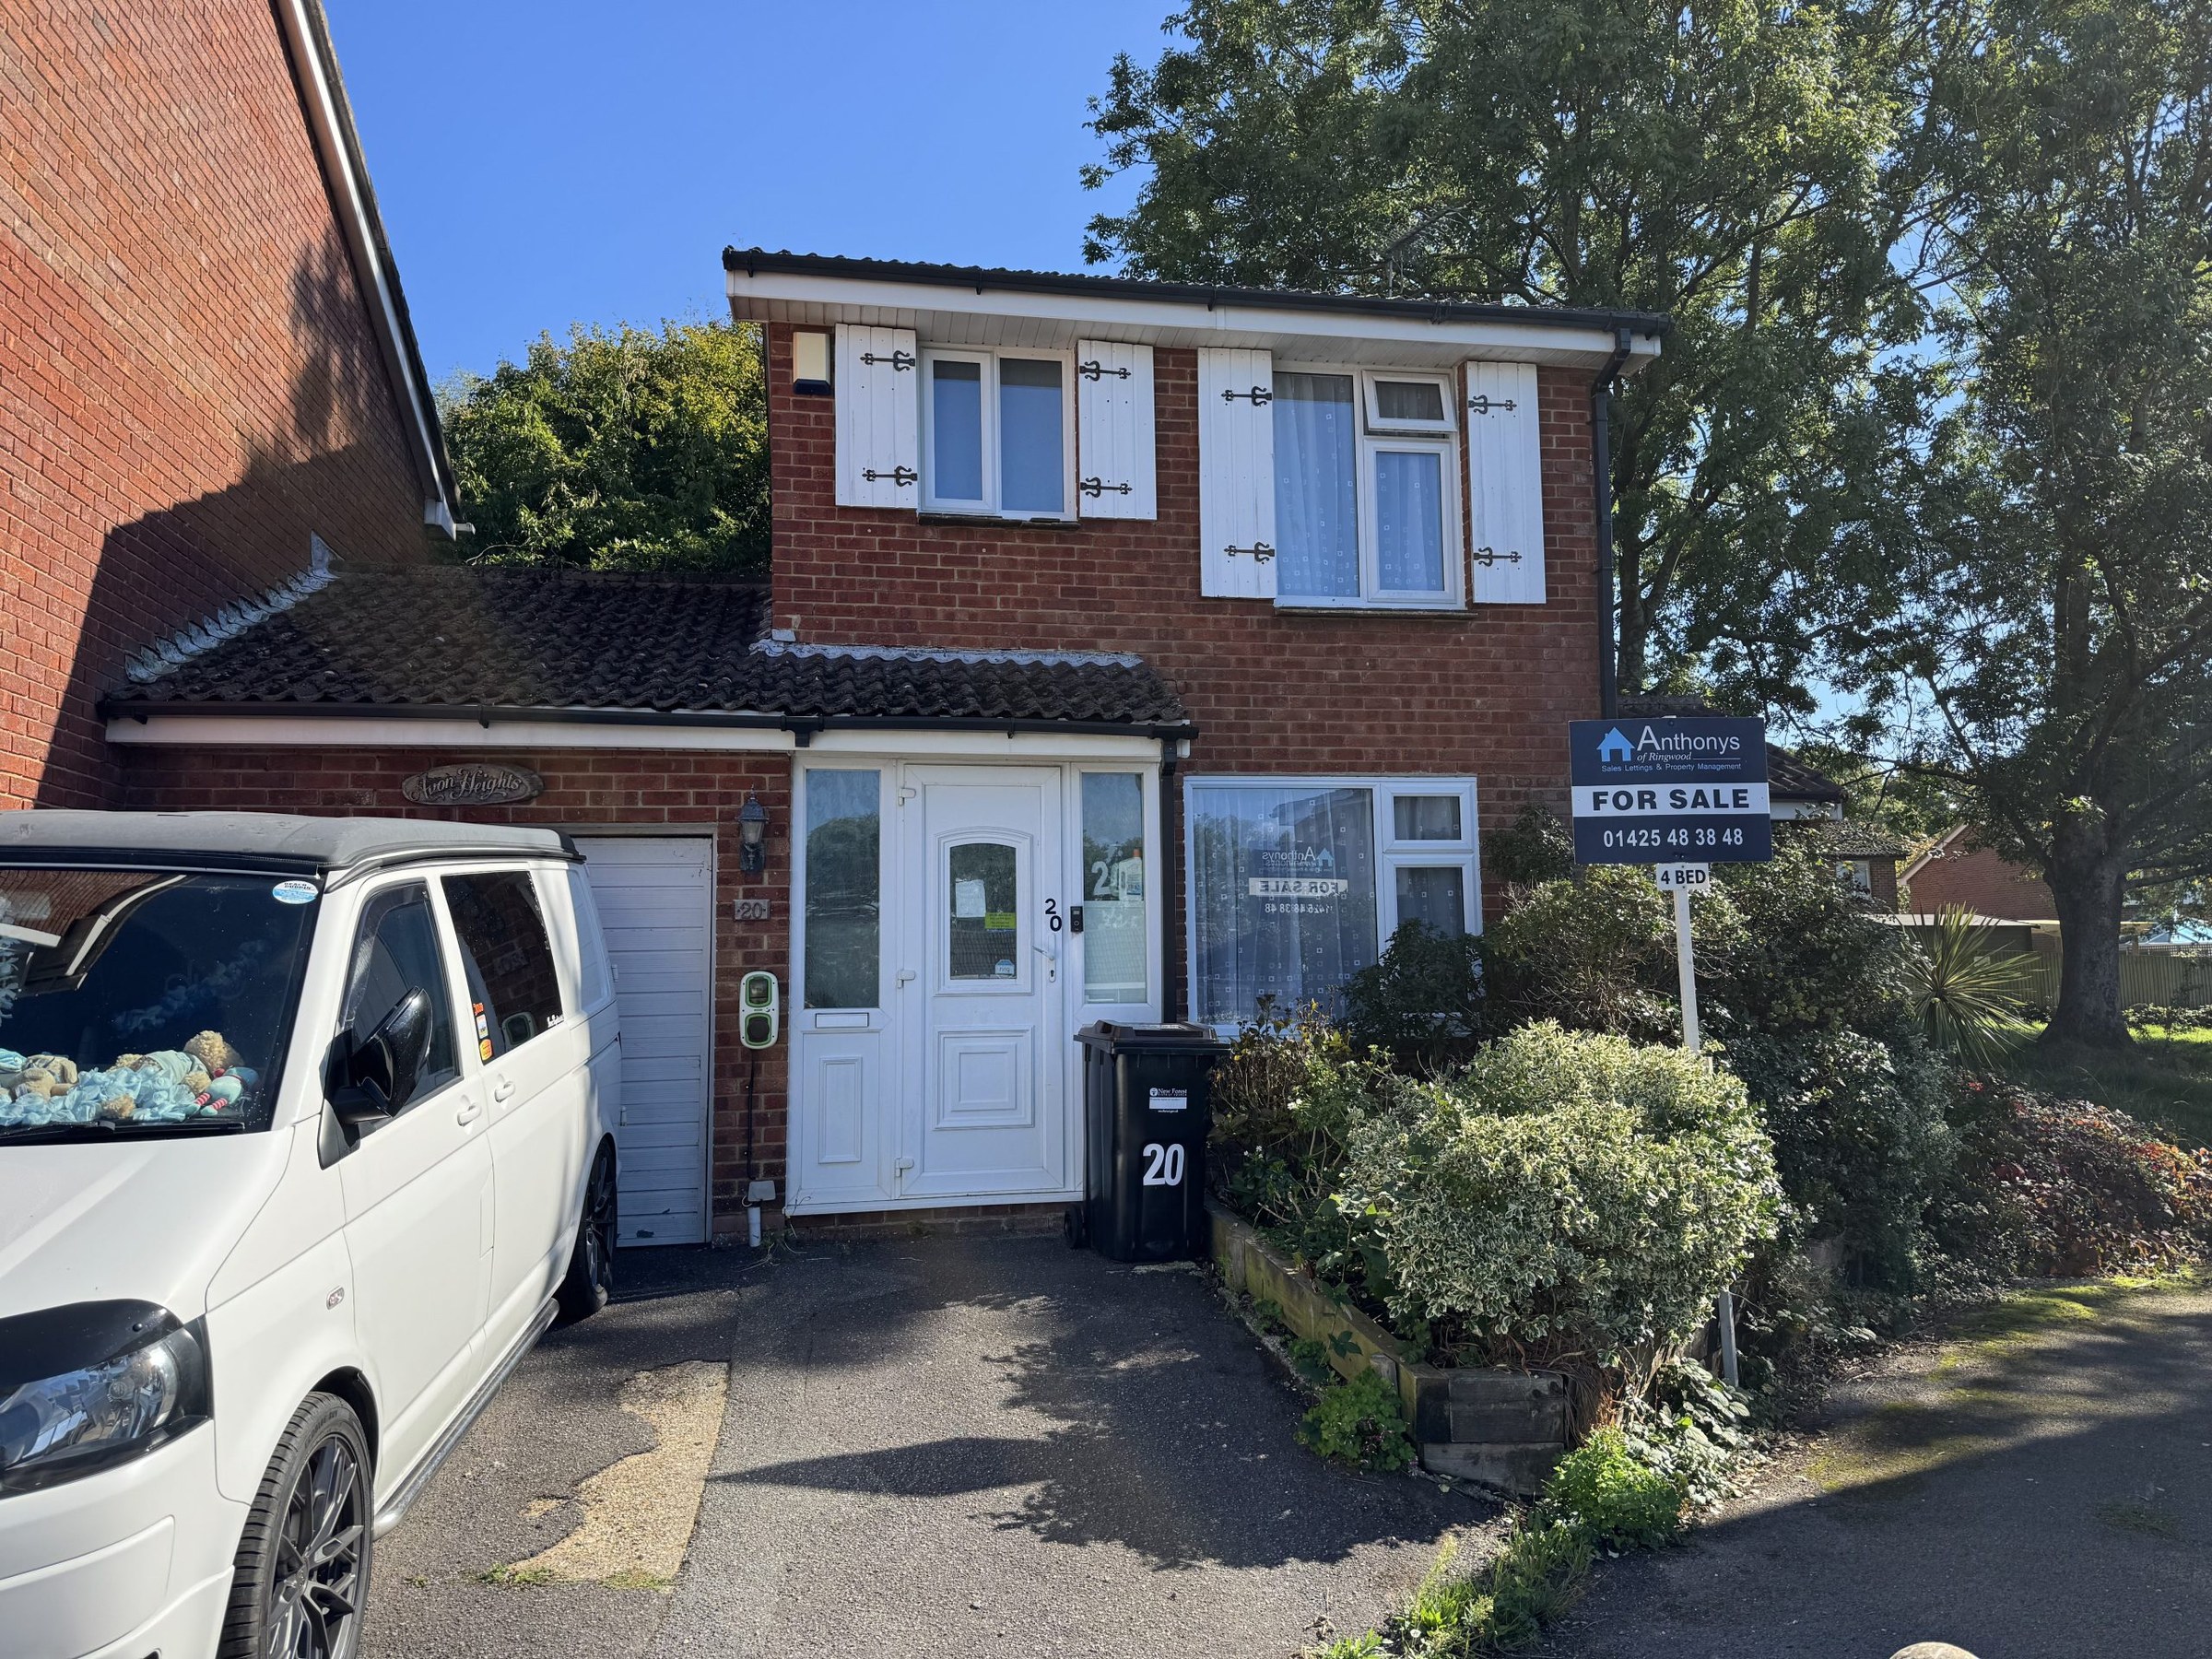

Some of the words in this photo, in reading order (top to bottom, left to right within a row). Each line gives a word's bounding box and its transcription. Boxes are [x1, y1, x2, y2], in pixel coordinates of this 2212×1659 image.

[1636, 724, 1741, 755] Anthonys
[1625, 764, 1653, 772] Lettings
[1665, 763, 1695, 771] Property
[1697, 762, 1742, 771] Management
[1636, 752, 1647, 762] of
[1648, 752, 1692, 763] Ringwood
[451, 769, 523, 800] Heights
[1592, 790, 1657, 811] FOR
[1669, 789, 1750, 809] SALE
[1603, 830, 1661, 848] 01425
[1666, 829, 1689, 846] 48
[1695, 829, 1716, 846] 38
[1722, 828, 1744, 846] 48
[1660, 870, 1670, 885] 4
[1676, 869, 1707, 885] BED
[740, 901, 763, 920] 20
[1143, 1143, 1184, 1186] 20
